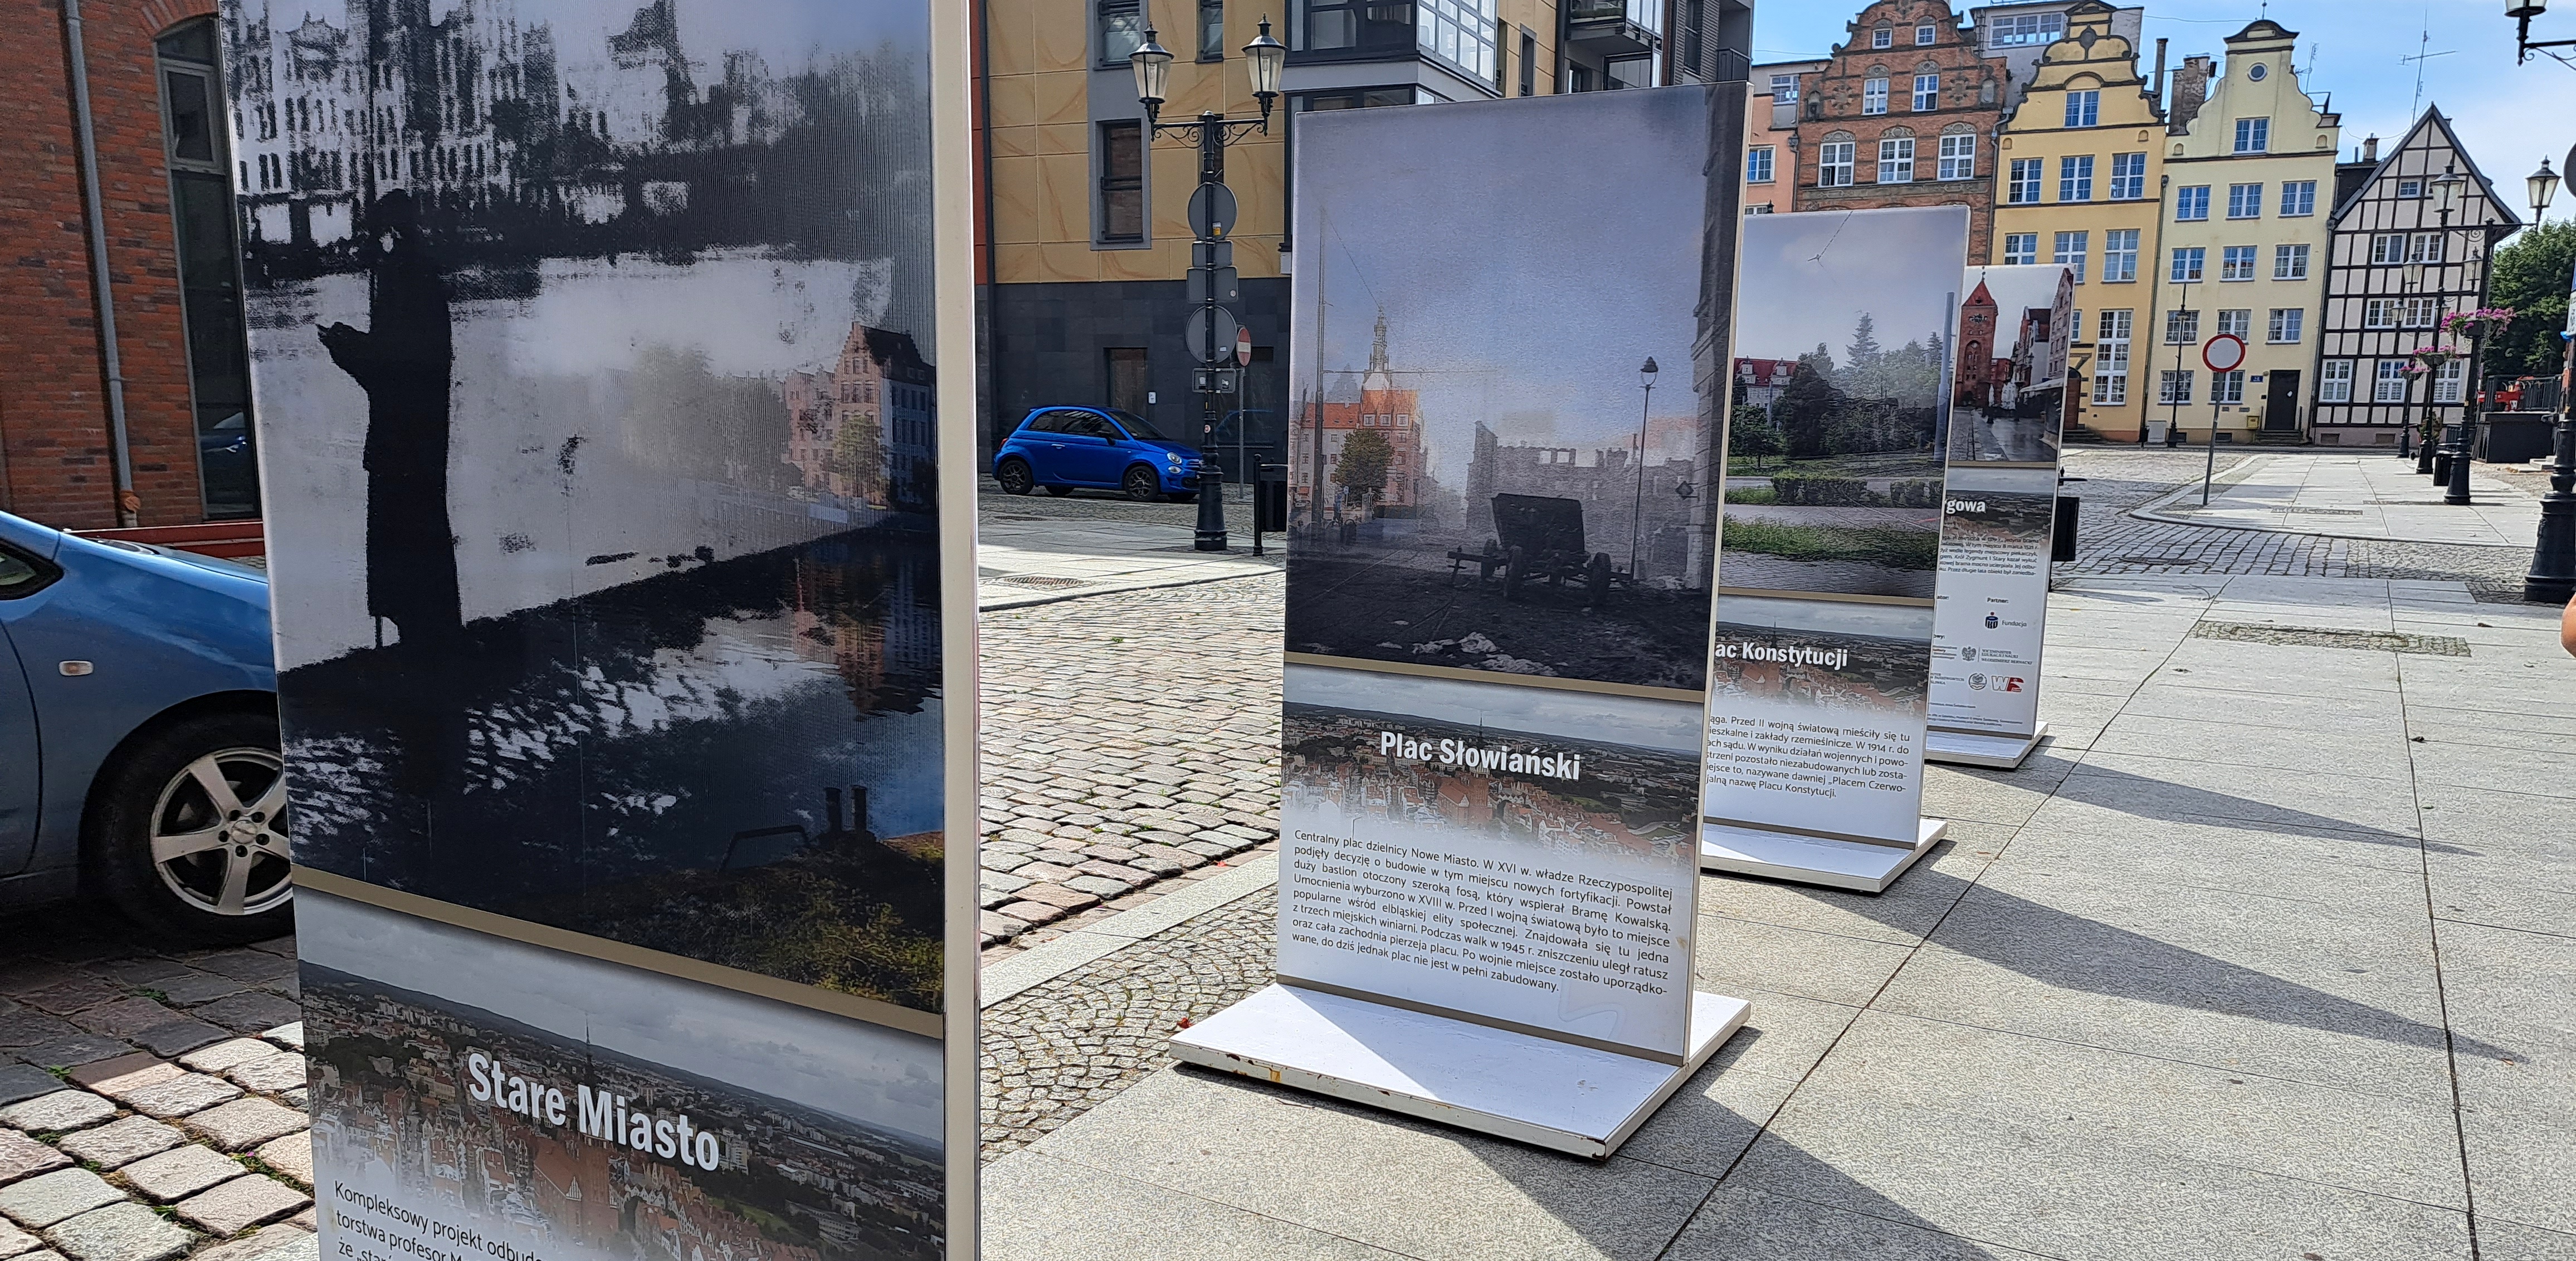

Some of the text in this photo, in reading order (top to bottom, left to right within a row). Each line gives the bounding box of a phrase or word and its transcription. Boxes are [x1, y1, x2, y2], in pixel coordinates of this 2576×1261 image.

[1945, 499, 1985, 514] gowa
[1715, 642, 1848, 671] ac Konstytucji
[1723, 741, 1745, 750] sądu.
[1747, 742, 1757, 751] W
[1758, 745, 1788, 754] wyniku
[1790, 747, 1822, 758] działań
[1823, 751, 1872, 764] wojennych
[1874, 755, 1877, 764] i
[1879, 758, 1909, 766] powo-
[1731, 716, 1755, 726] Przed
[1768, 721, 1794, 732] wojną
[1797, 722, 1839, 736] światową
[1843, 727, 1880, 740] mieściły
[1884, 731, 1897, 742] się
[1900, 733, 1910, 741] tu
[1750, 730, 1753, 739] i
[1755, 732, 1789, 744] zakłady
[1791, 736, 1853, 749] rzemieślnicze.
[1856, 741, 1866, 750] W
[1867, 744, 1886, 753] 1914
[1897, 745, 1909, 754] do
[1381, 731, 1580, 780] Plac Słowiański
[1733, 766, 1743, 775] to,
[1746, 769, 1789, 779] nazywane
[1792, 771, 1826, 785] dawniej
[1868, 780, 1906, 792] Czerwo-
[1735, 755, 1778, 765] pozostało
[1780, 759, 1860, 775] niezabudowanych
[1862, 767, 1876, 776] lub
[1878, 771, 1907, 779] zosta-
[1729, 779, 1757, 790] nazwę
[1759, 780, 1782, 790] Placu
[1785, 783, 1836, 799] Konstytucji.
[1295, 830, 1672, 901] Centralny plac dzielnicy Nowe Miasto. W XVI w. władze Rzeczypospolitej
[1295, 846, 1329, 861] podjęły
[1334, 850, 1370, 867] decyzję
[1385, 858, 1426, 874] budowie
[1431, 868, 1439, 877] w
[1444, 869, 1463, 881] tym
[1468, 874, 1508, 888] miejscu
[1514, 882, 1554, 896] nowych
[1560, 887, 1620, 908] fortyfikacji.
[1627, 898, 1672, 915] Powstał
[1294, 859, 1671, 933] duży bastion otoczony szeroką fosą, który wspierał Bramę Kowalską.
[1294, 873, 1670, 947] Umocnienia wyburzono w XVIII w. Przed I wojną światową było to miejsce
[1294, 890, 1668, 964] popularne wśród elbląskiej elity społecznej. Znajdowała się tu jedna
[1301, 904, 1330, 917] trzech
[1333, 910, 1377, 926] miejskich
[1379, 918, 1418, 933] winiarni.
[1421, 925, 1461, 941] Podczas
[1464, 935, 1487, 947] walk
[1490, 940, 1499, 949] w
[1501, 942, 1525, 954] 1945
[1537, 949, 1599, 966] zniszczeniu
[1602, 959, 1631, 975] uległ
[1633, 966, 1668, 980] ratusz
[1292, 919, 1667, 995] oraz cała zachodnia pierzeja placu. Po wojnie miejsce zostało uporządko-
[1292, 933, 1319, 946] wane,
[1321, 937, 1334, 947] do
[1336, 939, 1354, 951] dziś
[1357, 942, 1389, 957] jednak
[1392, 950, 1411, 962] plac
[1414, 955, 1428, 965] nie
[1431, 957, 1448, 970] jest
[1462, 966, 1487, 977] pełni
[1490, 970, 1559, 993] zabudowany.
[466, 1053, 720, 1172] Stare Miasto
[335, 1180, 428, 1234] Kompleksowy
[433, 1221, 483, 1251] projekt
[336, 1210, 446, 1261] torstwa profesor
[339, 1236, 353, 1258] że
